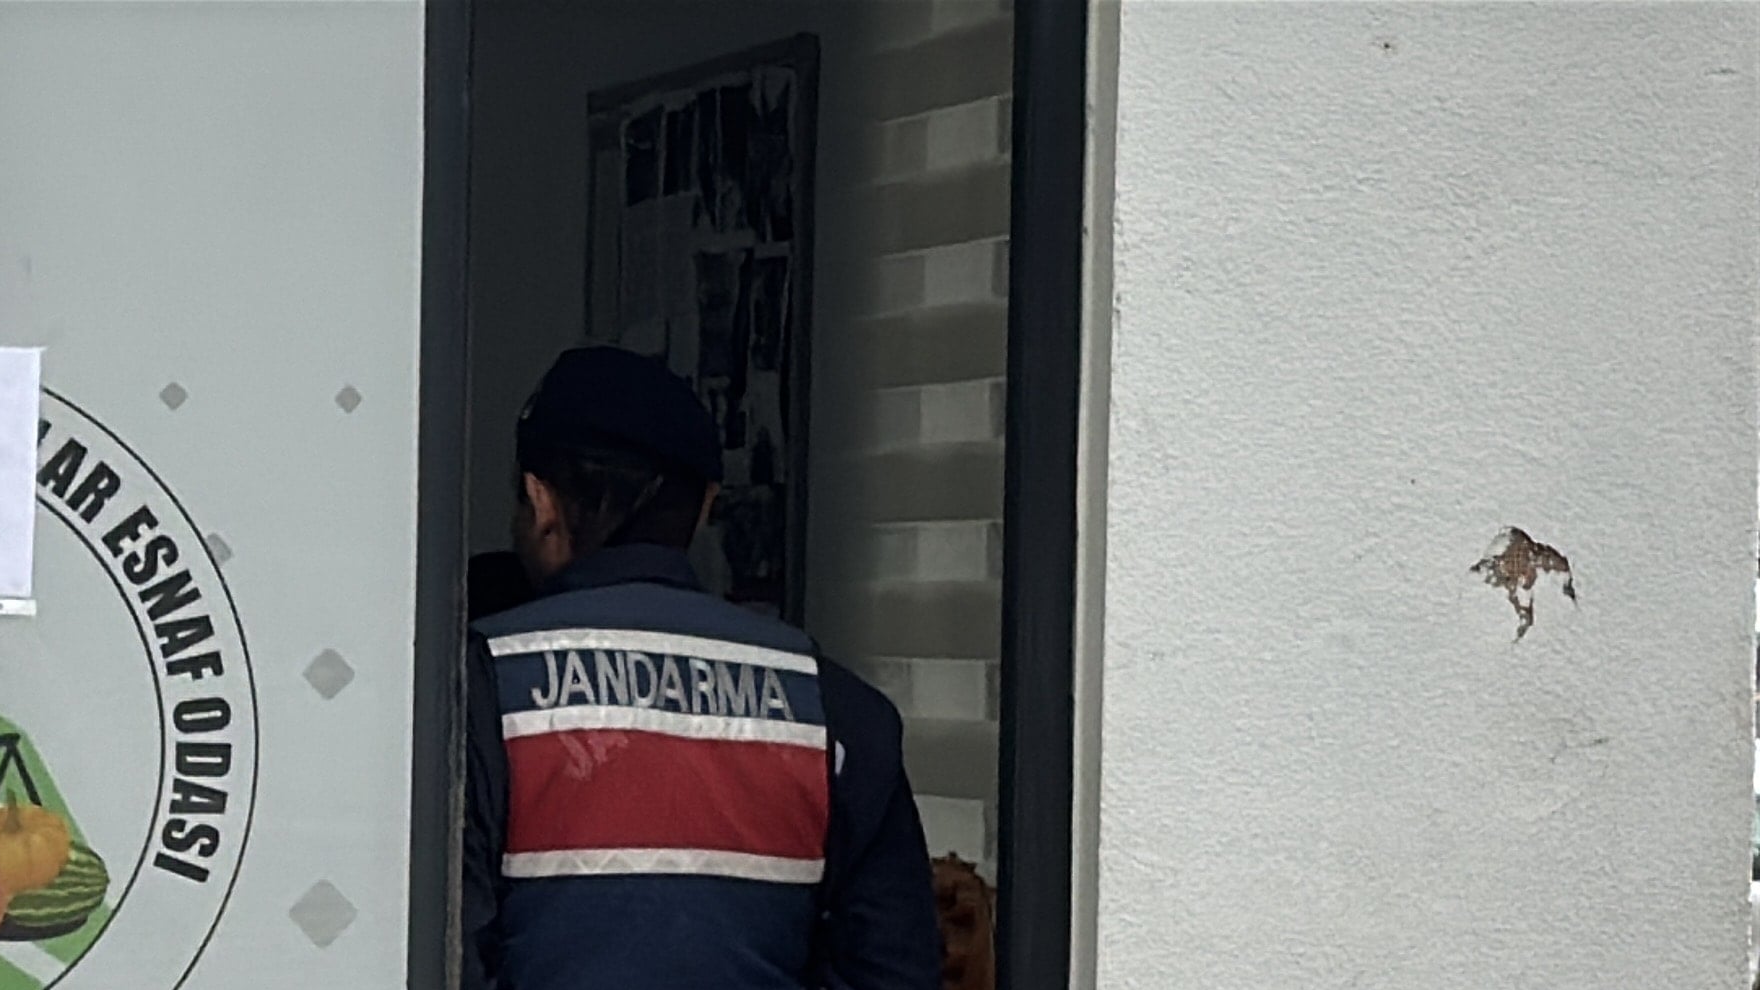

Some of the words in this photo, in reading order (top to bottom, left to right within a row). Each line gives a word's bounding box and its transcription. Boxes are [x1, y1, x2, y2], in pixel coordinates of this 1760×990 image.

[37, 418, 121, 524] AR
[101, 504, 223, 680] ESNAF
[532, 648, 794, 722] JANDARMA
[153, 697, 232, 883] ODASI
